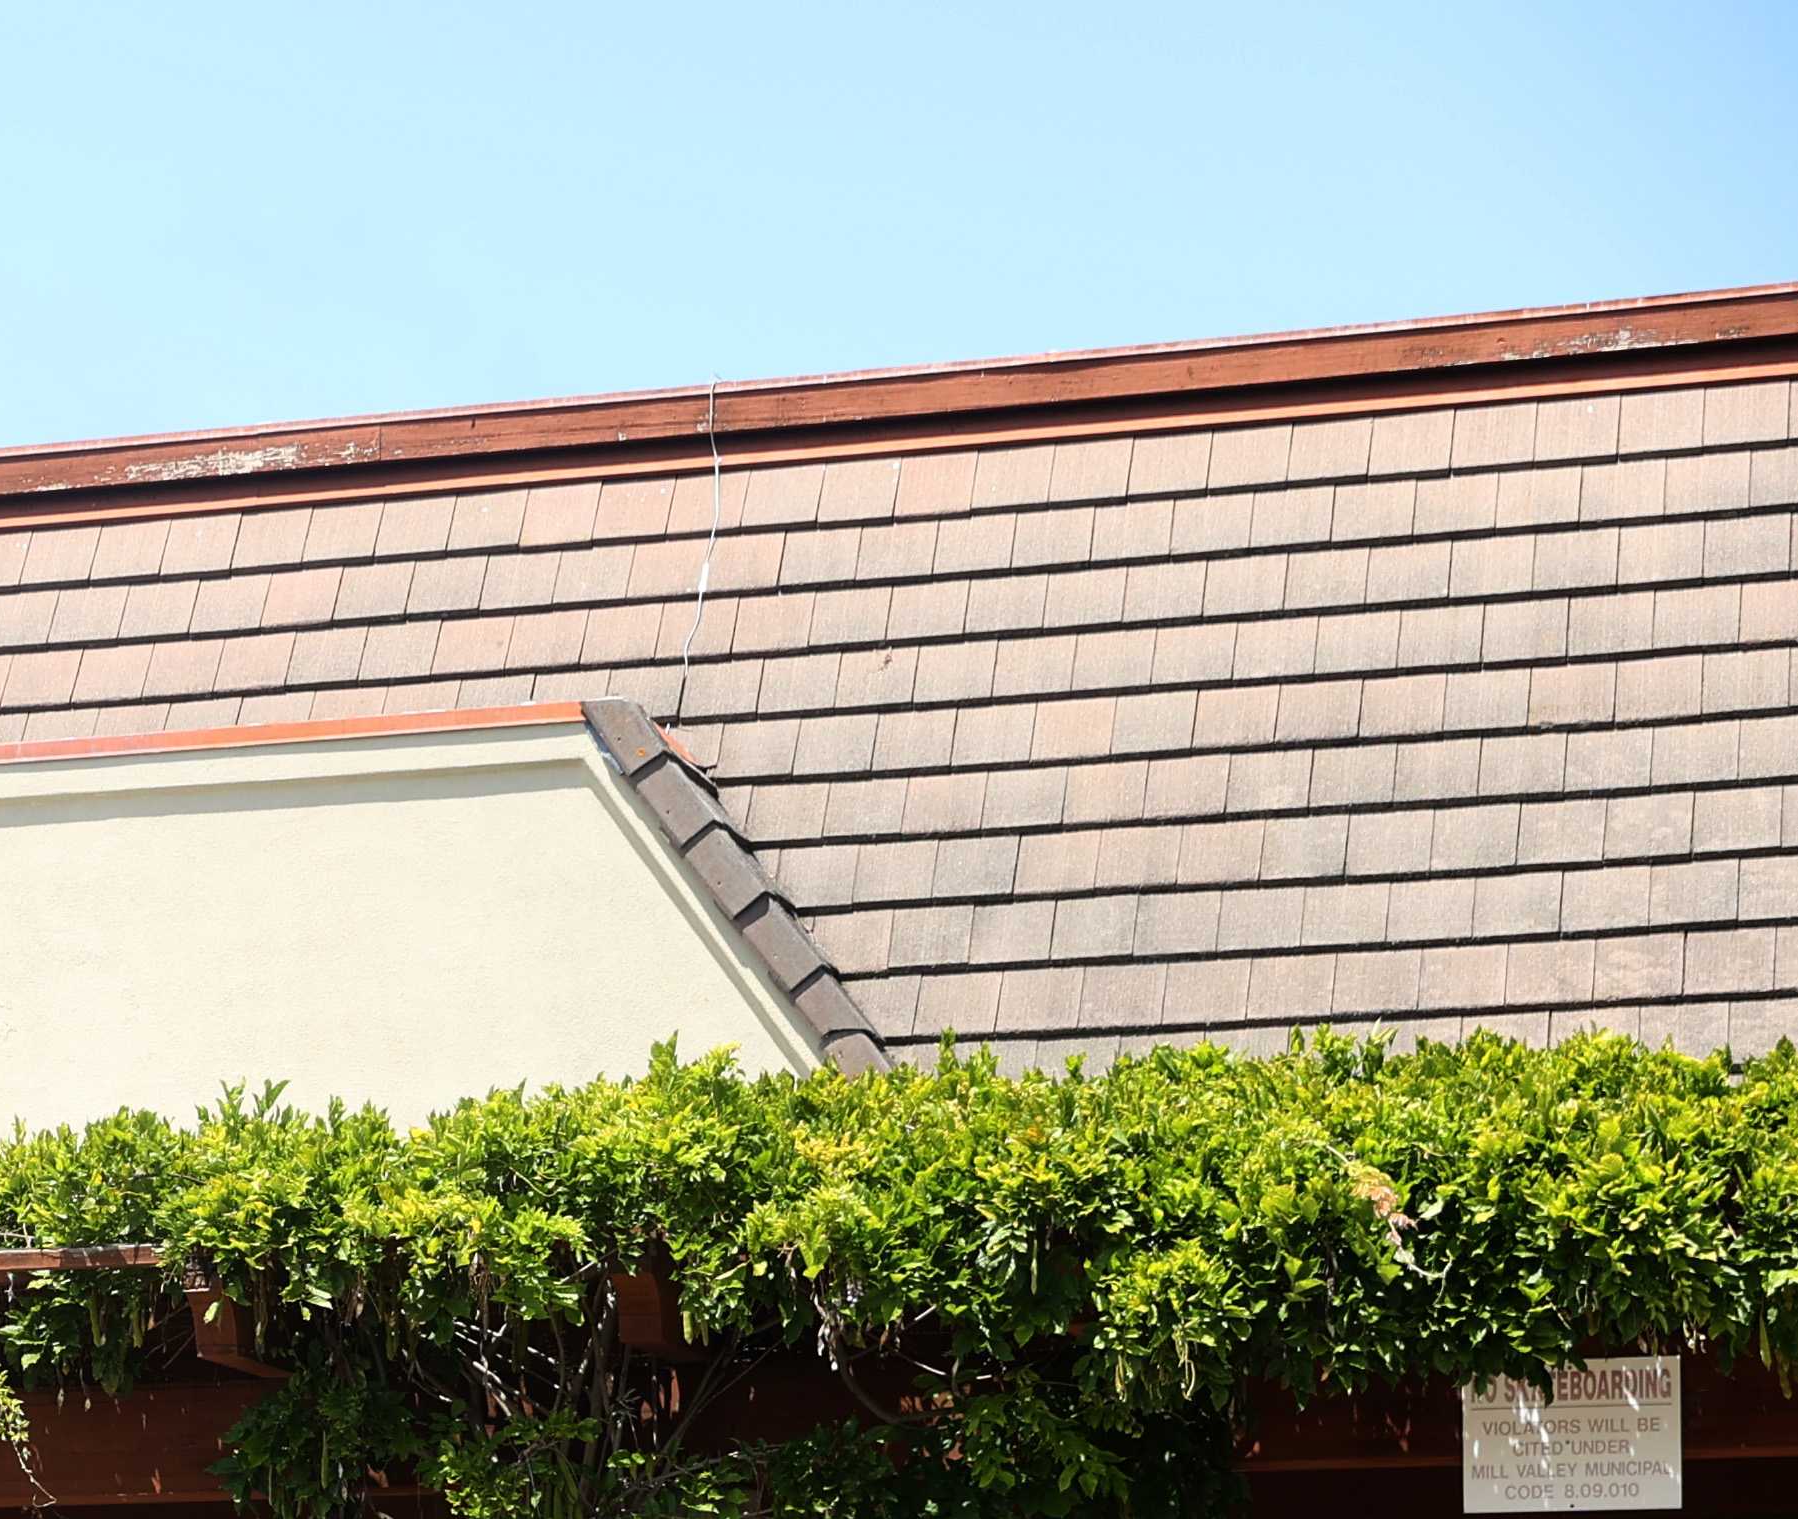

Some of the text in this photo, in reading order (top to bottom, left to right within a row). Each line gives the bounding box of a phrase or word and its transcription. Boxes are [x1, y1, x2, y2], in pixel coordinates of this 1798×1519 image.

[1482, 1417, 1661, 1436] VIOLATORS WILL BE
[1512, 1440, 1630, 1457] CITED UNDER
[1471, 1461, 1671, 1480] MILL VALLEY MUNICIPAL
[1505, 1483, 1640, 1501] CODE 8.09.010
